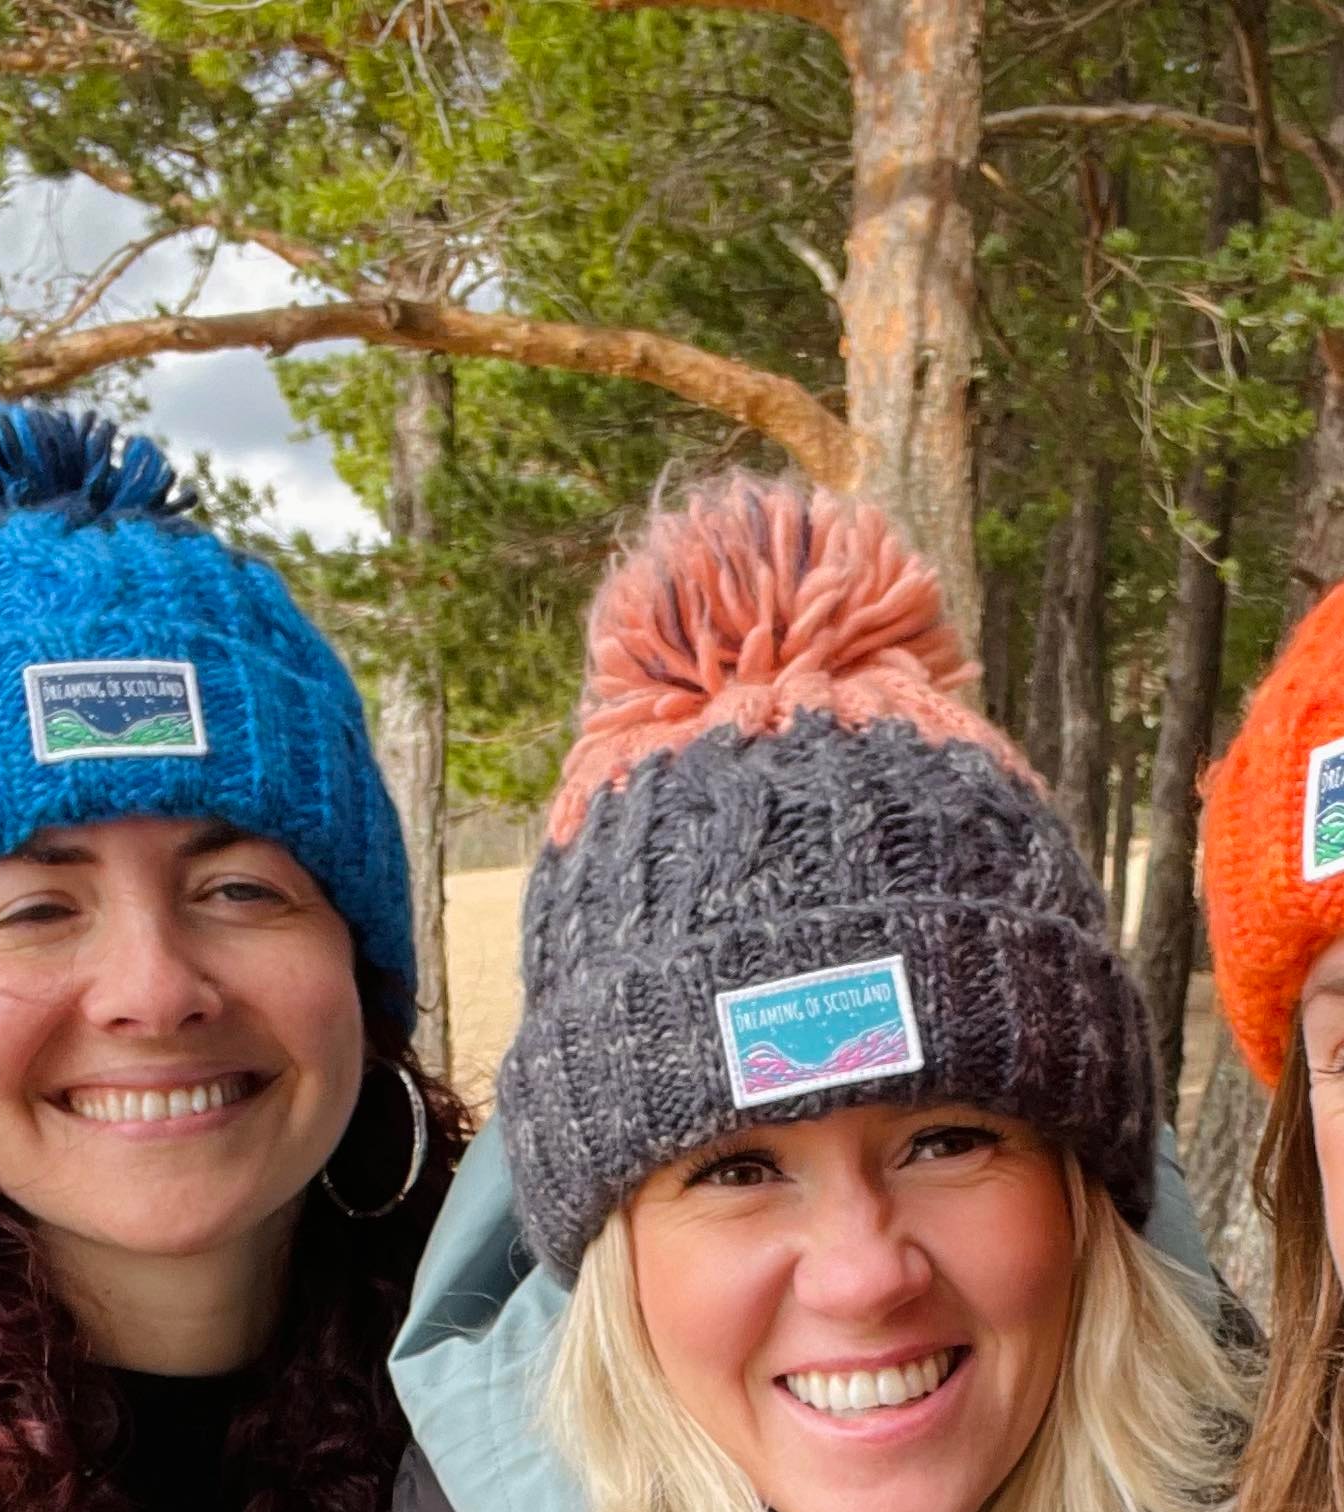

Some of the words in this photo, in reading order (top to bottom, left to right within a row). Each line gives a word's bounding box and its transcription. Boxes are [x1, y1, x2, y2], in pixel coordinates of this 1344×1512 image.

[42, 681, 105, 702] DREAMING
[106, 682, 121, 697] OF
[122, 680, 185, 697] SCOTLAND
[735, 1003, 804, 1032] DREAMING
[805, 999, 821, 1018] OF
[823, 983, 892, 1014] SCOTLAND
